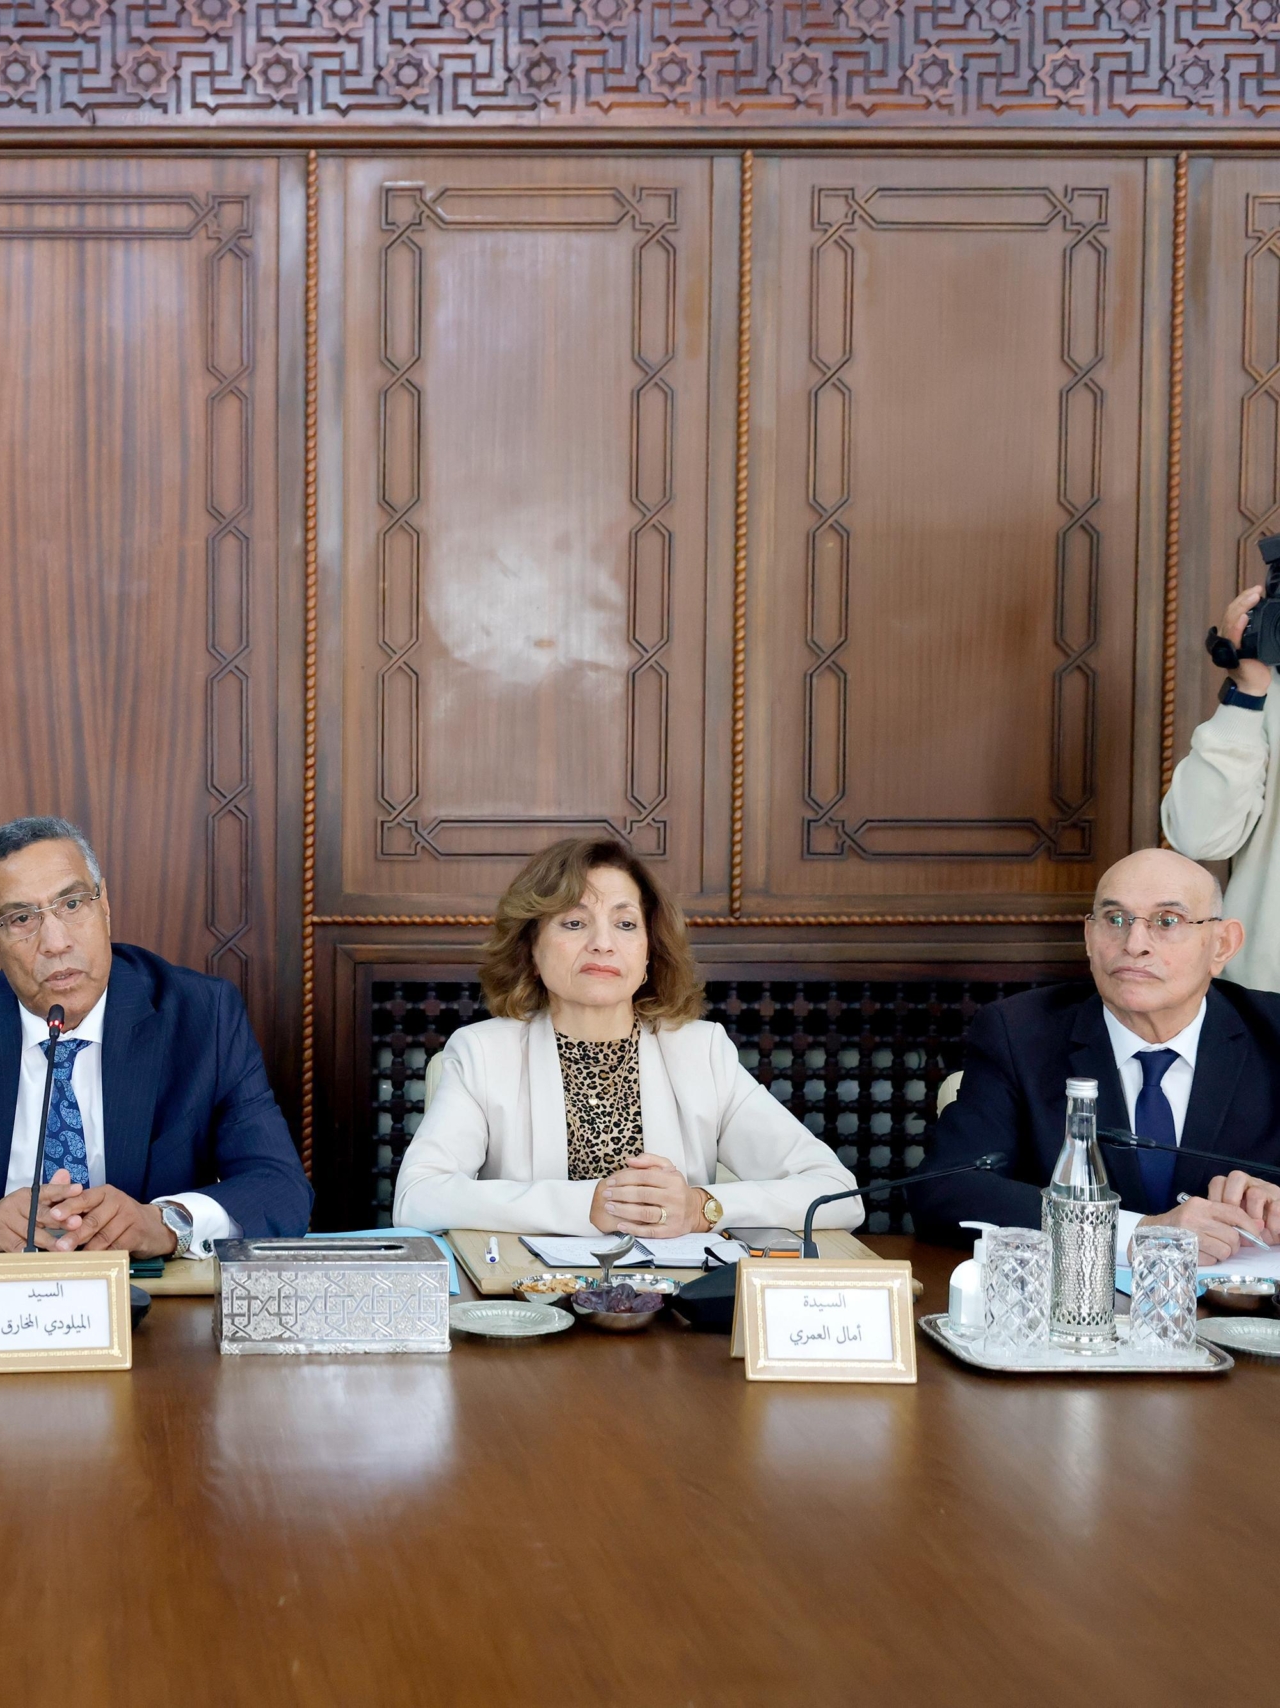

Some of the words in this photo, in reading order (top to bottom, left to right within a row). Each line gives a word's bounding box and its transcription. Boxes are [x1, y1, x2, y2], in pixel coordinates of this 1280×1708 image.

[26, 1281, 63, 1302] السيد
[803, 1292, 846, 1311] السيدة
[1, 1314, 38, 1335] المخارق
[44, 1314, 91, 1336] الميلودي
[836, 1324, 862, 1344] أمال
[789, 1325, 830, 1346] العمري
